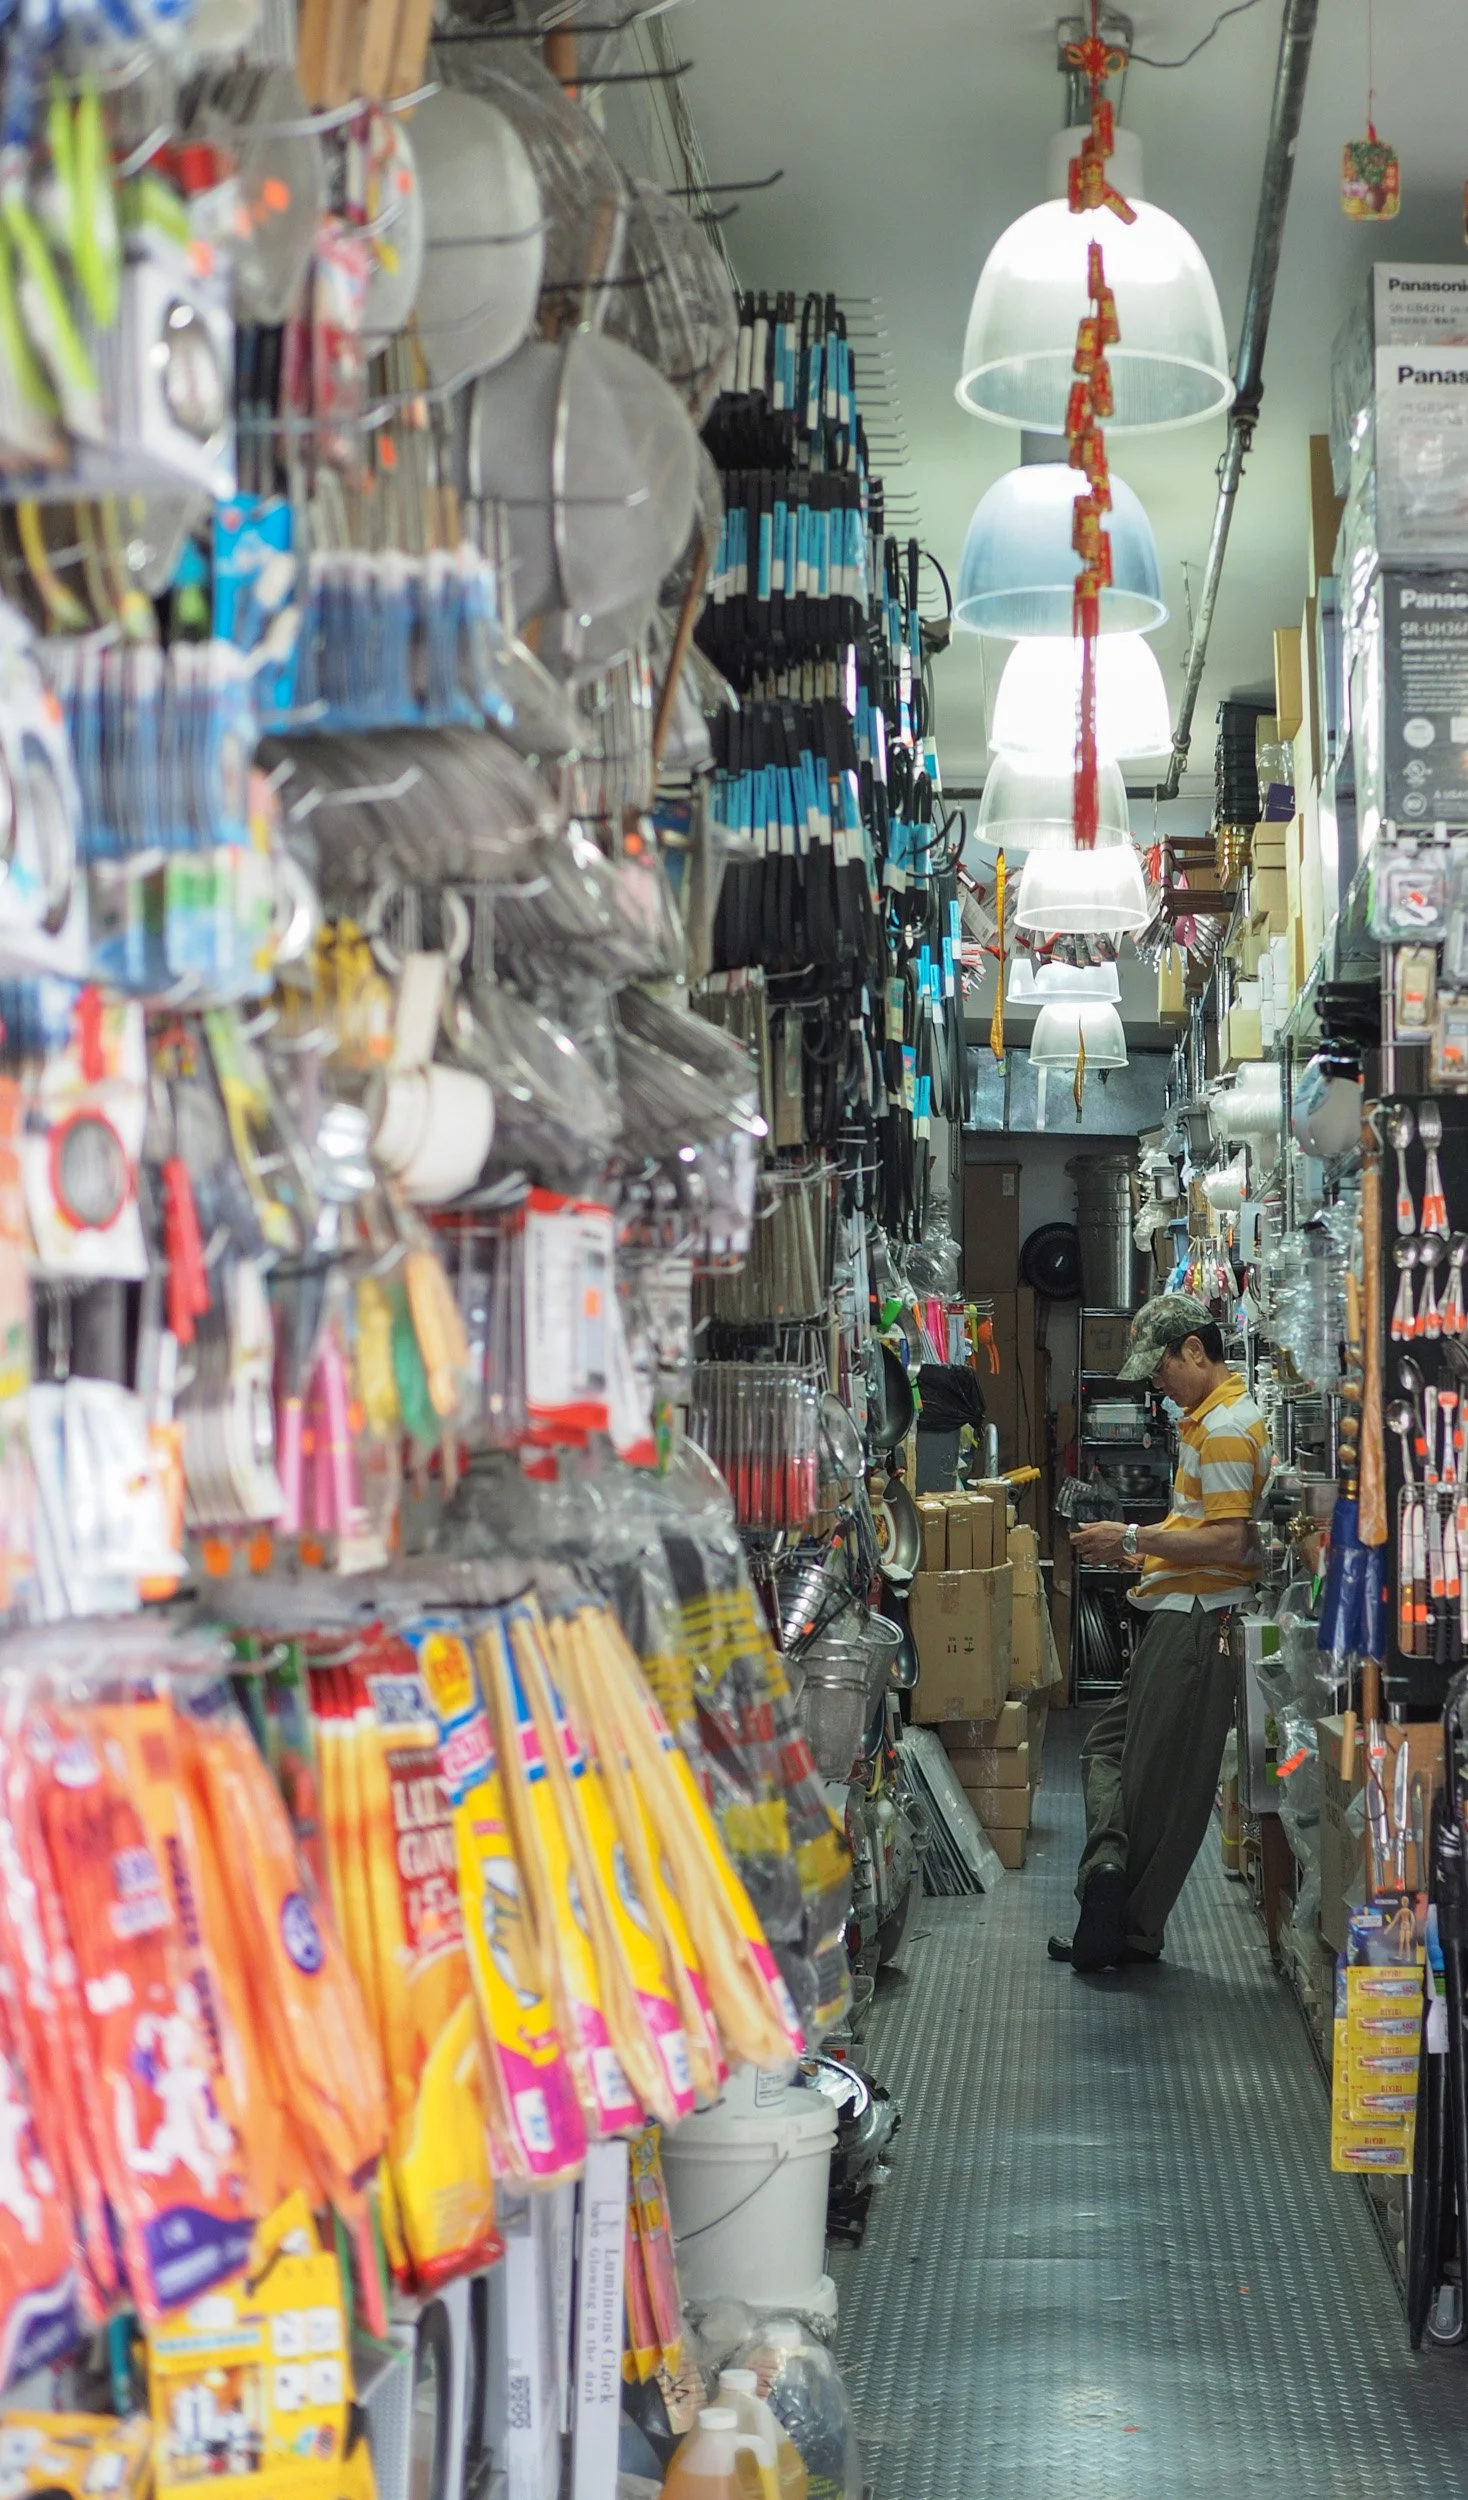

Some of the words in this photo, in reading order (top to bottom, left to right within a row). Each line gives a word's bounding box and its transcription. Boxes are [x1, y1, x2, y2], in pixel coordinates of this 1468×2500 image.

[584, 2246, 600, 2310] Glowing
[602, 2248, 619, 2344] Luminous
[585, 2316, 598, 2330] in
[584, 2338, 597, 2363] the
[583, 2371, 597, 2404] dark
[600, 2348, 616, 2404] Clock
